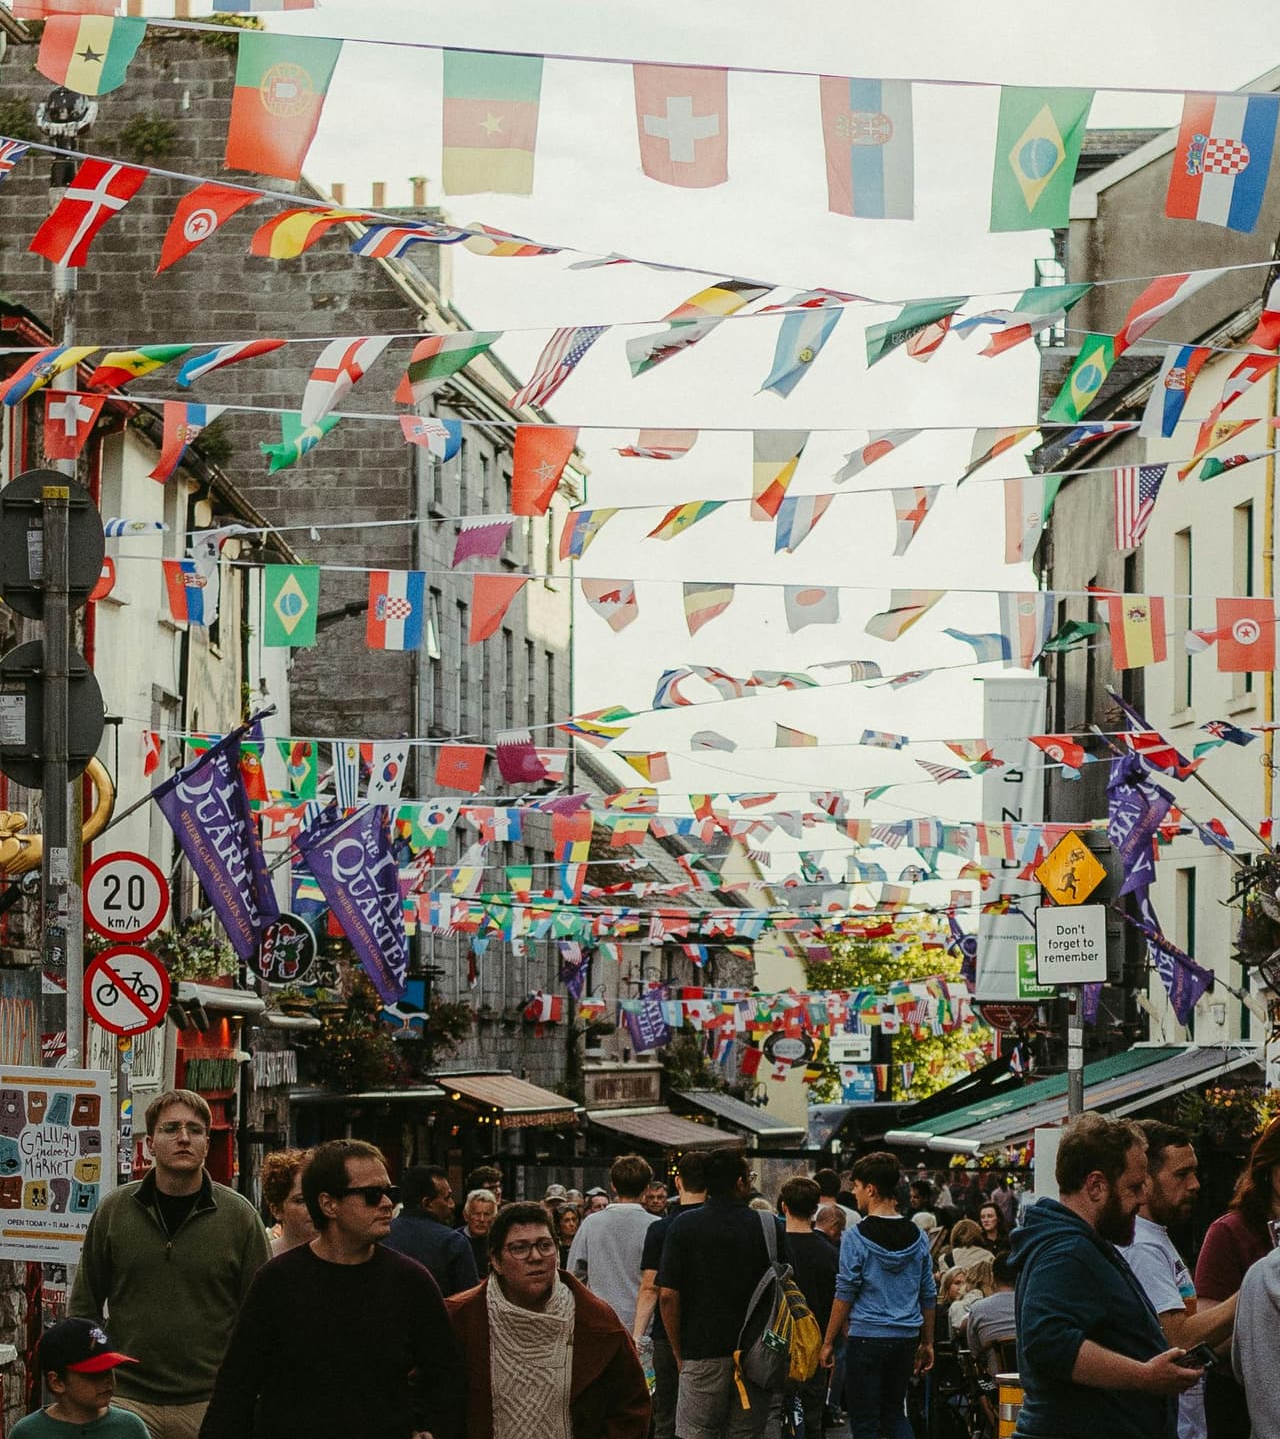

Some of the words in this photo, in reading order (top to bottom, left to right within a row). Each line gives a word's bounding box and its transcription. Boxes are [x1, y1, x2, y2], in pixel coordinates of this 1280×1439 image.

[103, 874, 145, 911] 20
[323, 837, 408, 988] QUARTER
[107, 915, 141, 929] km/h
[1056, 924, 1085, 936] Don't
[1048, 938, 1080, 950] forget
[1083, 937, 1094, 948] to
[1044, 952, 1099, 963] remember
[1023, 985, 1055, 994] Lottery
[20, 1127, 77, 1156] GALWAY
[7, 1218, 25, 1226] OPEN
[26, 1220, 47, 1228] TODAY
